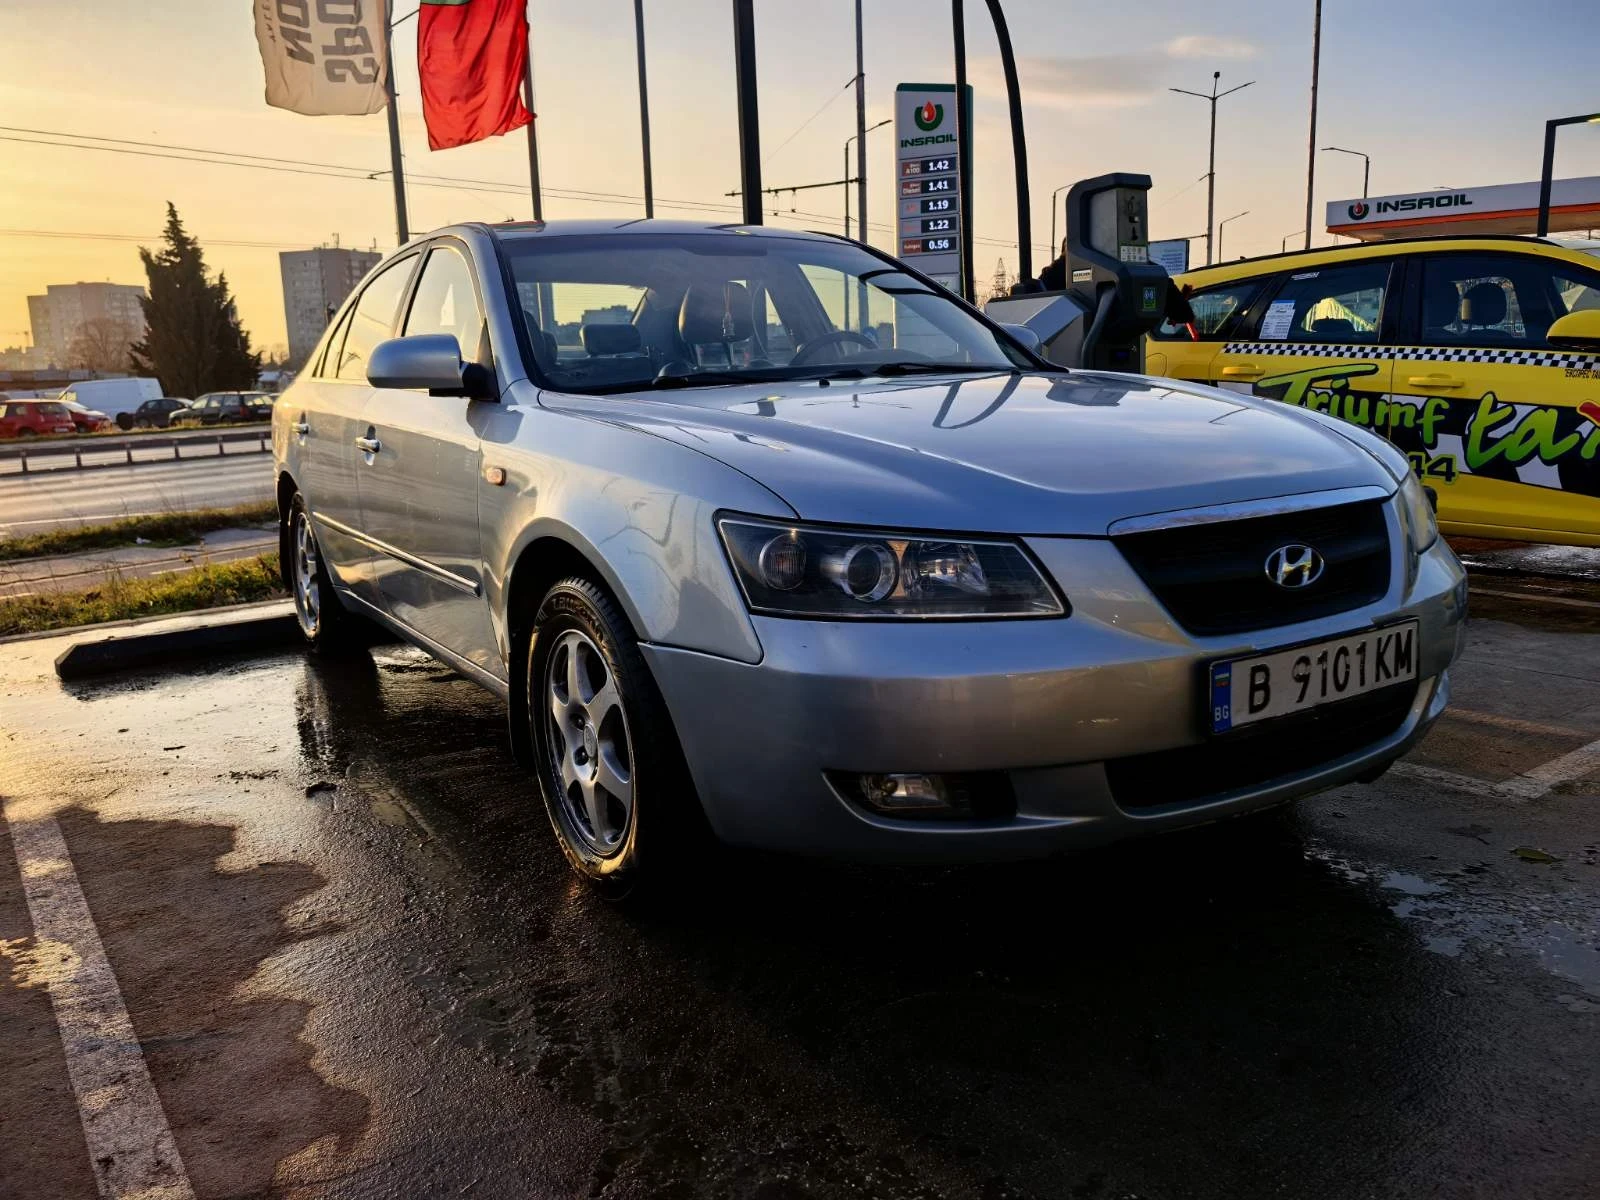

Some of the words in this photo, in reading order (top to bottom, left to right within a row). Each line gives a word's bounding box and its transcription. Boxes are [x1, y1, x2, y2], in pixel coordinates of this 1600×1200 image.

[900, 134, 957, 148] INSAOIL
[929, 160, 949, 171] 1.42
[929, 180, 949, 190] 1.41
[929, 200, 949, 210] 1.19
[1376, 194, 1473, 213] INSAOIL
[929, 220, 949, 230] 1.22
[929, 239, 949, 250] 0.56
[1256, 363, 1450, 445] Triumf
[1248, 663, 1271, 714] B
[1214, 705, 1230, 721] BG
